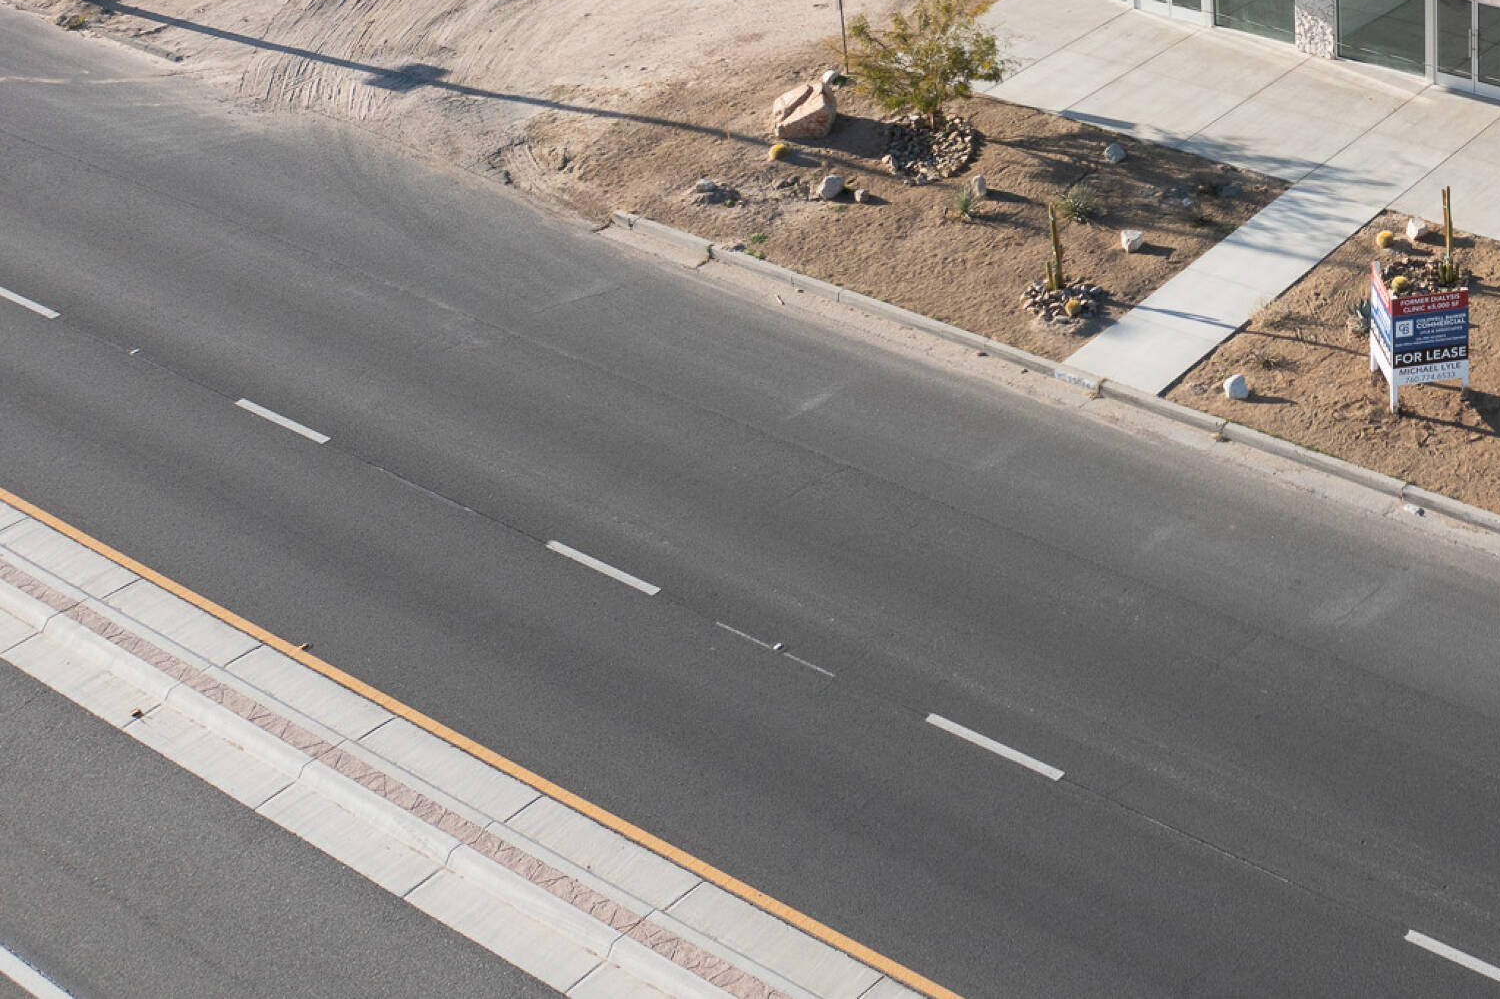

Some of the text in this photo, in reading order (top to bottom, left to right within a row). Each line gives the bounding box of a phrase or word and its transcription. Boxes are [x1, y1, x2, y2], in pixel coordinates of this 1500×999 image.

[1416, 317, 1465, 329] COMMERCIAL
[1395, 346, 1467, 365] FOR LEASE
[1399, 365, 1438, 376] MICHAEL
